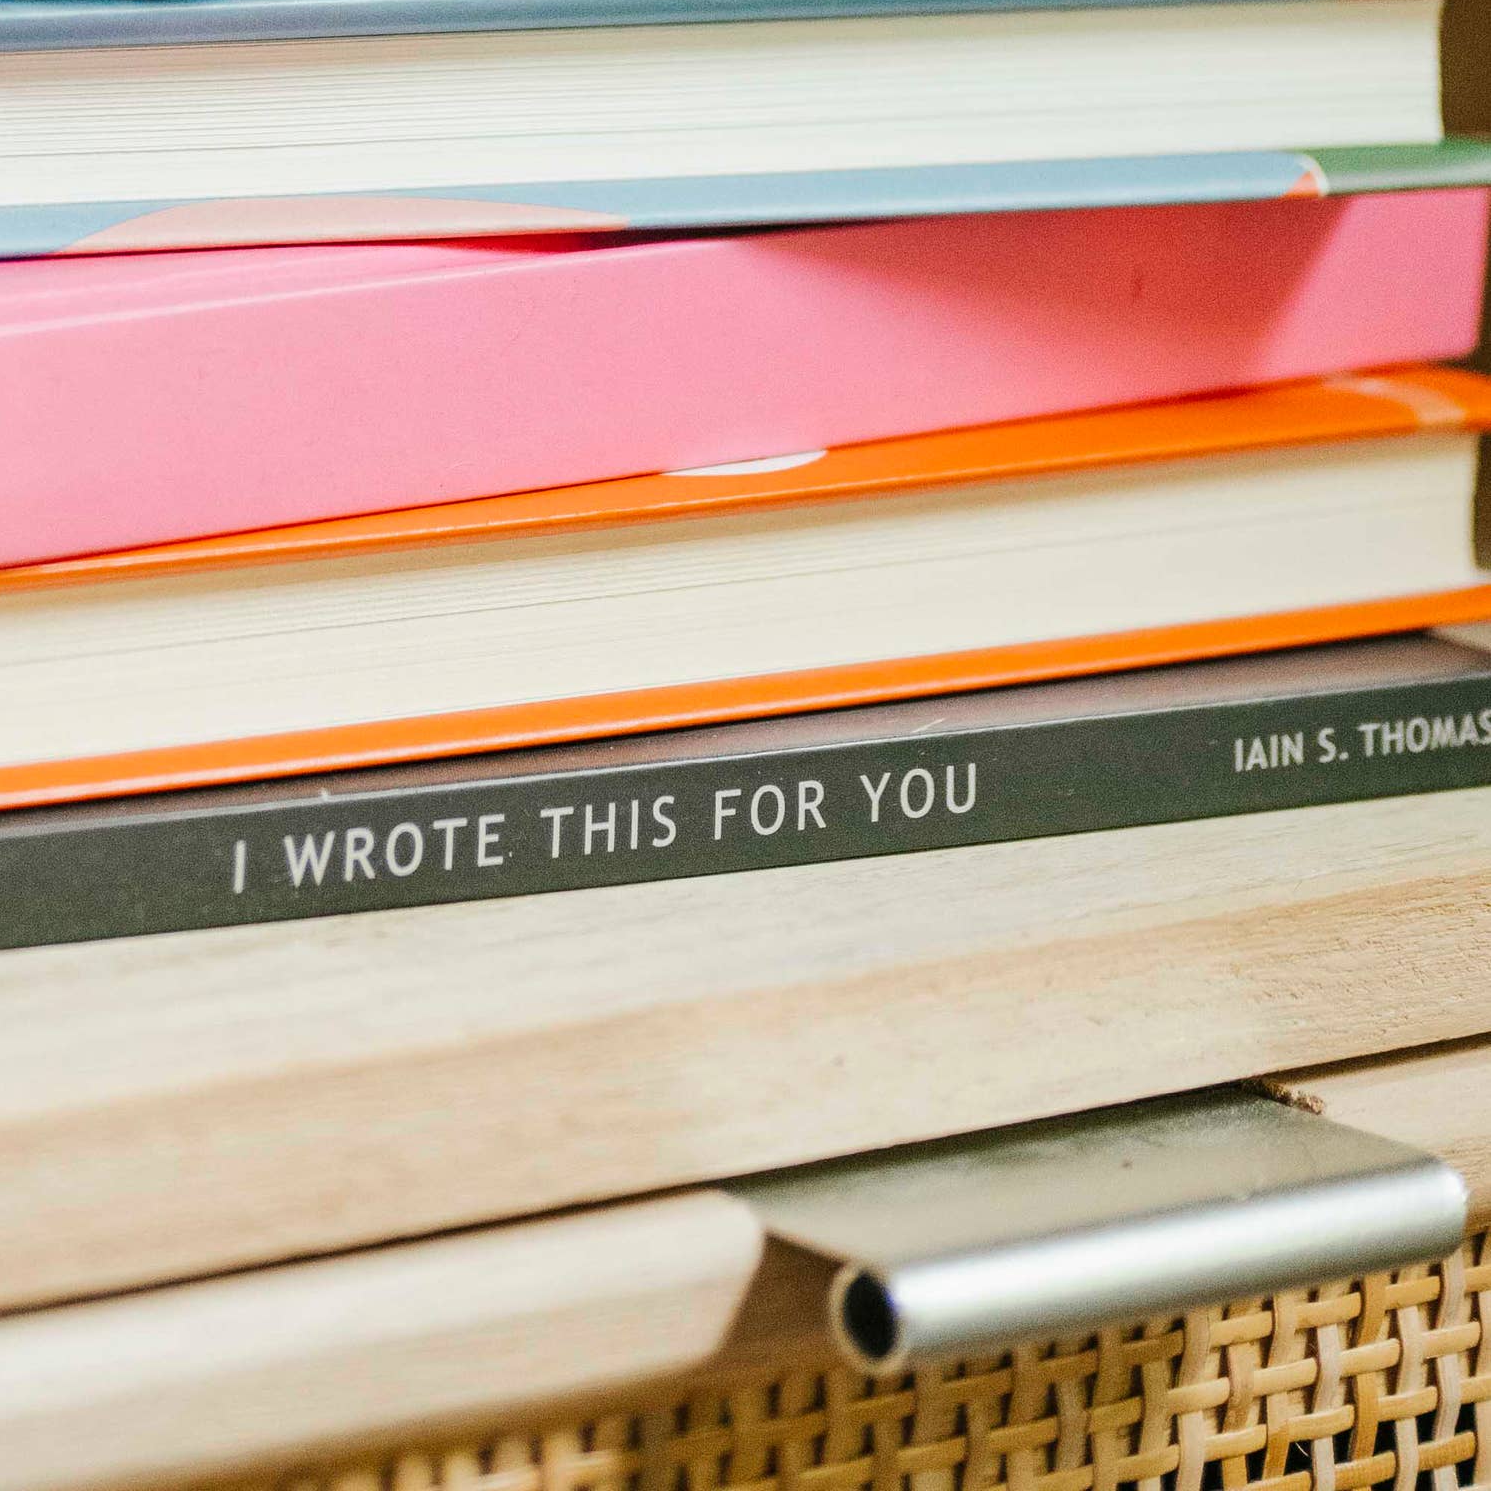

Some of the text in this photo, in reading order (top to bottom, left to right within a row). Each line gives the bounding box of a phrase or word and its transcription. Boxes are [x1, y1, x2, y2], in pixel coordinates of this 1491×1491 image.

[1233, 708, 1491, 773] IAIN S. THOMAS
[232, 761, 978, 895] I WROTE THIS FOR YOU
